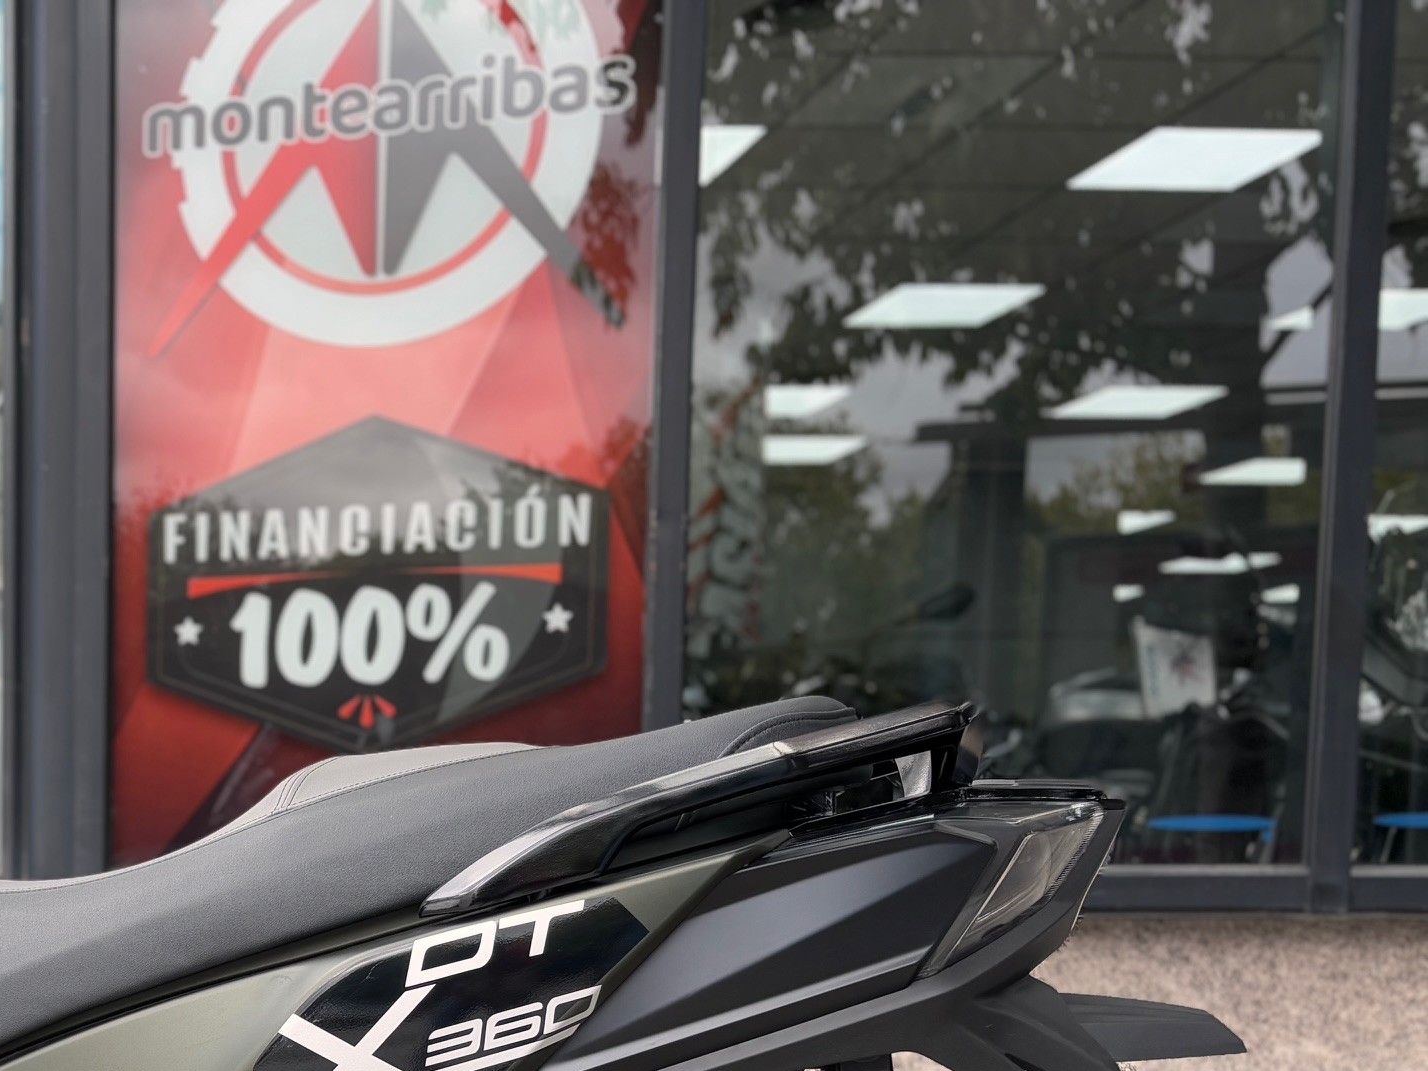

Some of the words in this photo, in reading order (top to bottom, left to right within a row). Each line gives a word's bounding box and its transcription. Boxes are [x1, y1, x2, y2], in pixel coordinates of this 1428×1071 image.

[146, 53, 633, 154] montearribas
[163, 484, 592, 564] FINANCIACIÓN
[229, 581, 510, 689] 100%
[405, 900, 585, 988] DT
[425, 985, 602, 1067] 360
